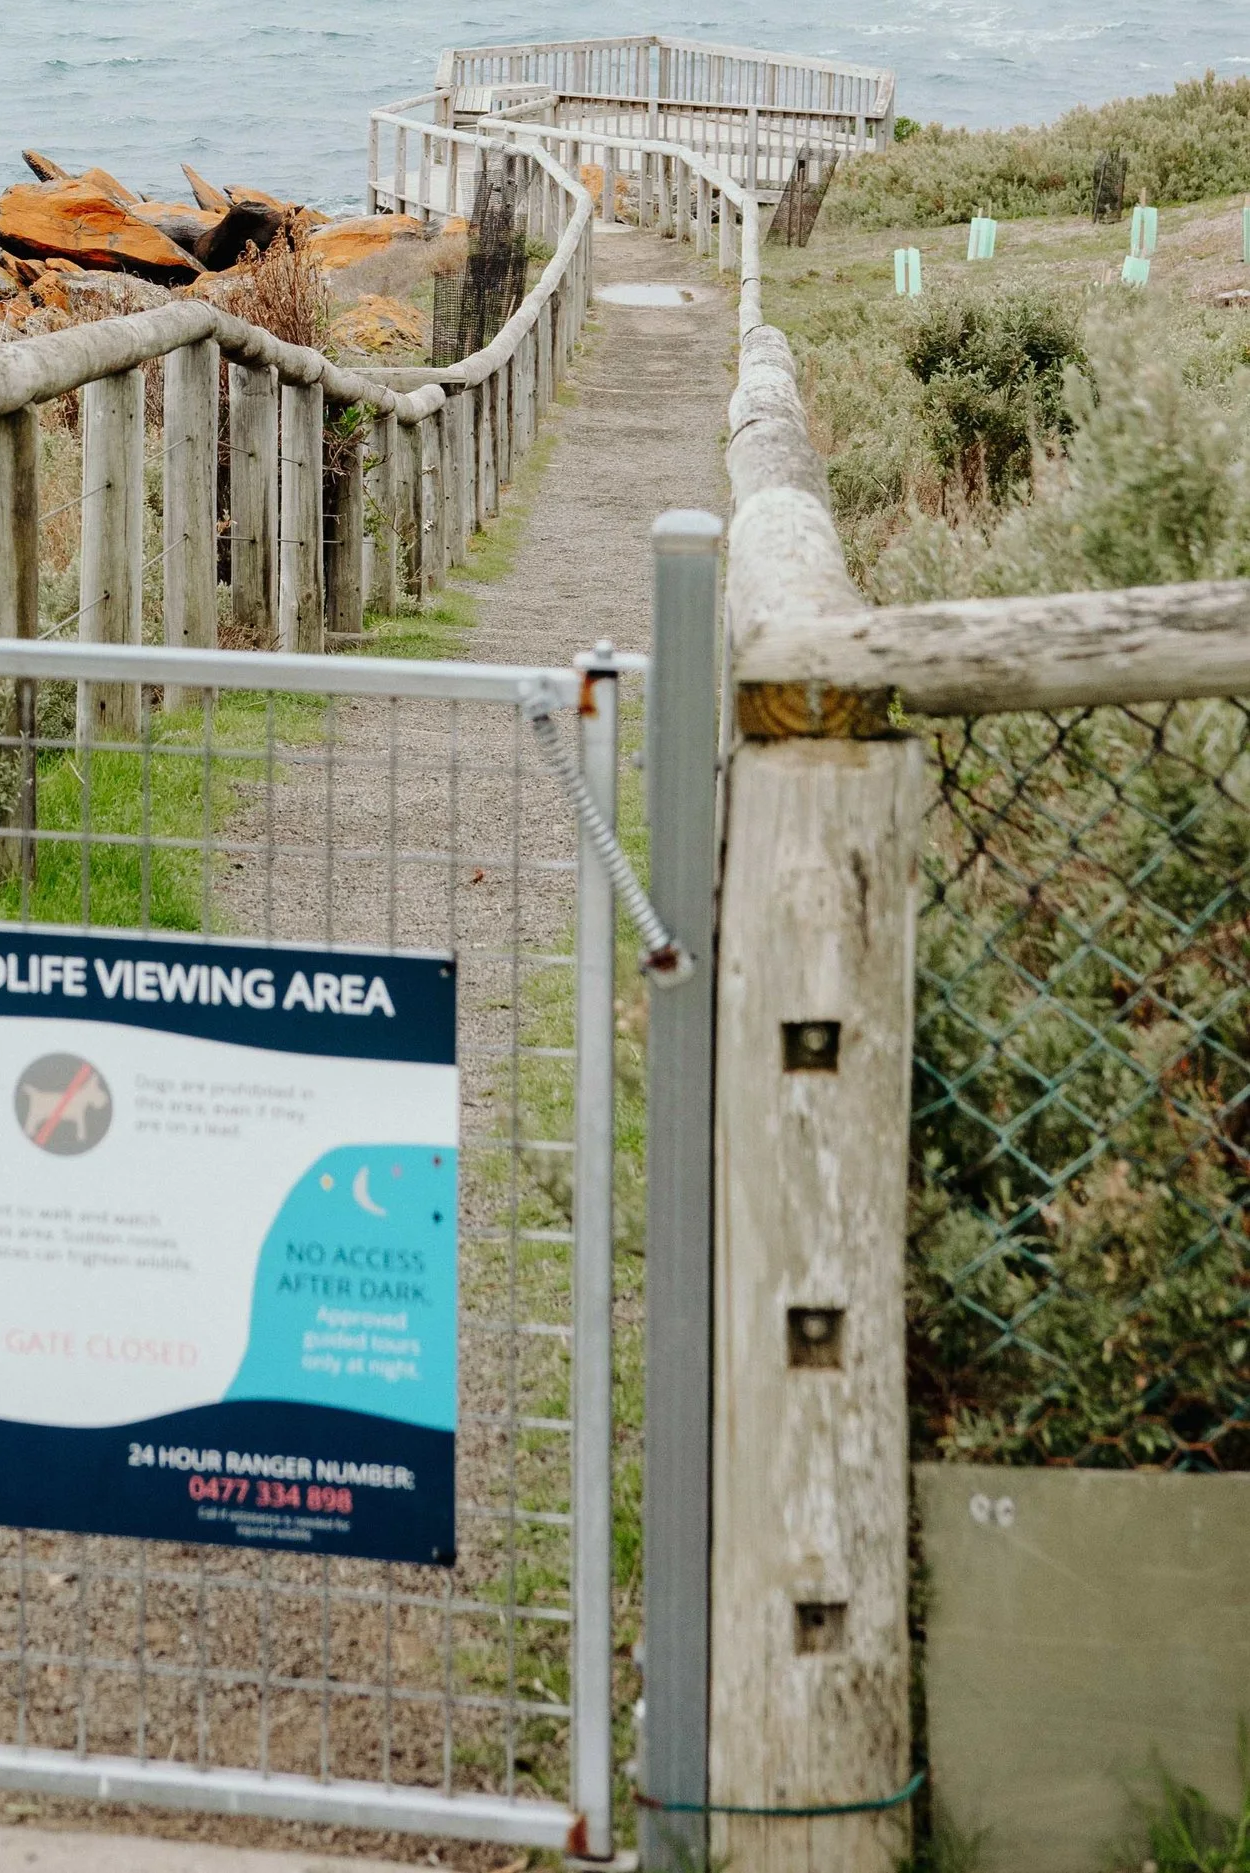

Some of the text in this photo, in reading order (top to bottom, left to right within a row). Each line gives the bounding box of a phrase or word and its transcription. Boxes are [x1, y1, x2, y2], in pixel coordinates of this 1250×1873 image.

[93, 958, 275, 1009] VIEWING
[283, 971, 395, 1017] AREA
[134, 1072, 316, 1100] Dogs are prohibited in
[134, 1096, 163, 1112] this
[213, 1103, 252, 1118] even
[270, 1104, 306, 1125] they
[134, 1120, 162, 1134] are
[165, 1121, 187, 1135] on
[38, 1206, 72, 1221] walk
[78, 1209, 109, 1224] and
[112, 1210, 162, 1228] watch
[34, 1248, 63, 1263] can
[286, 1240, 426, 1275] NO ACCESS
[276, 1272, 352, 1300] AFTER
[316, 1305, 409, 1332] Approved
[5, 1327, 77, 1359] GATE
[85, 1333, 199, 1368] CLOSED
[302, 1330, 421, 1357] guided tours
[301, 1353, 341, 1377] only
[345, 1357, 366, 1375] at
[128, 1442, 417, 1491] 24 HOUR RANGER NUMBER:
[188, 1474, 251, 1504] 0477
[255, 1480, 301, 1509] 334
